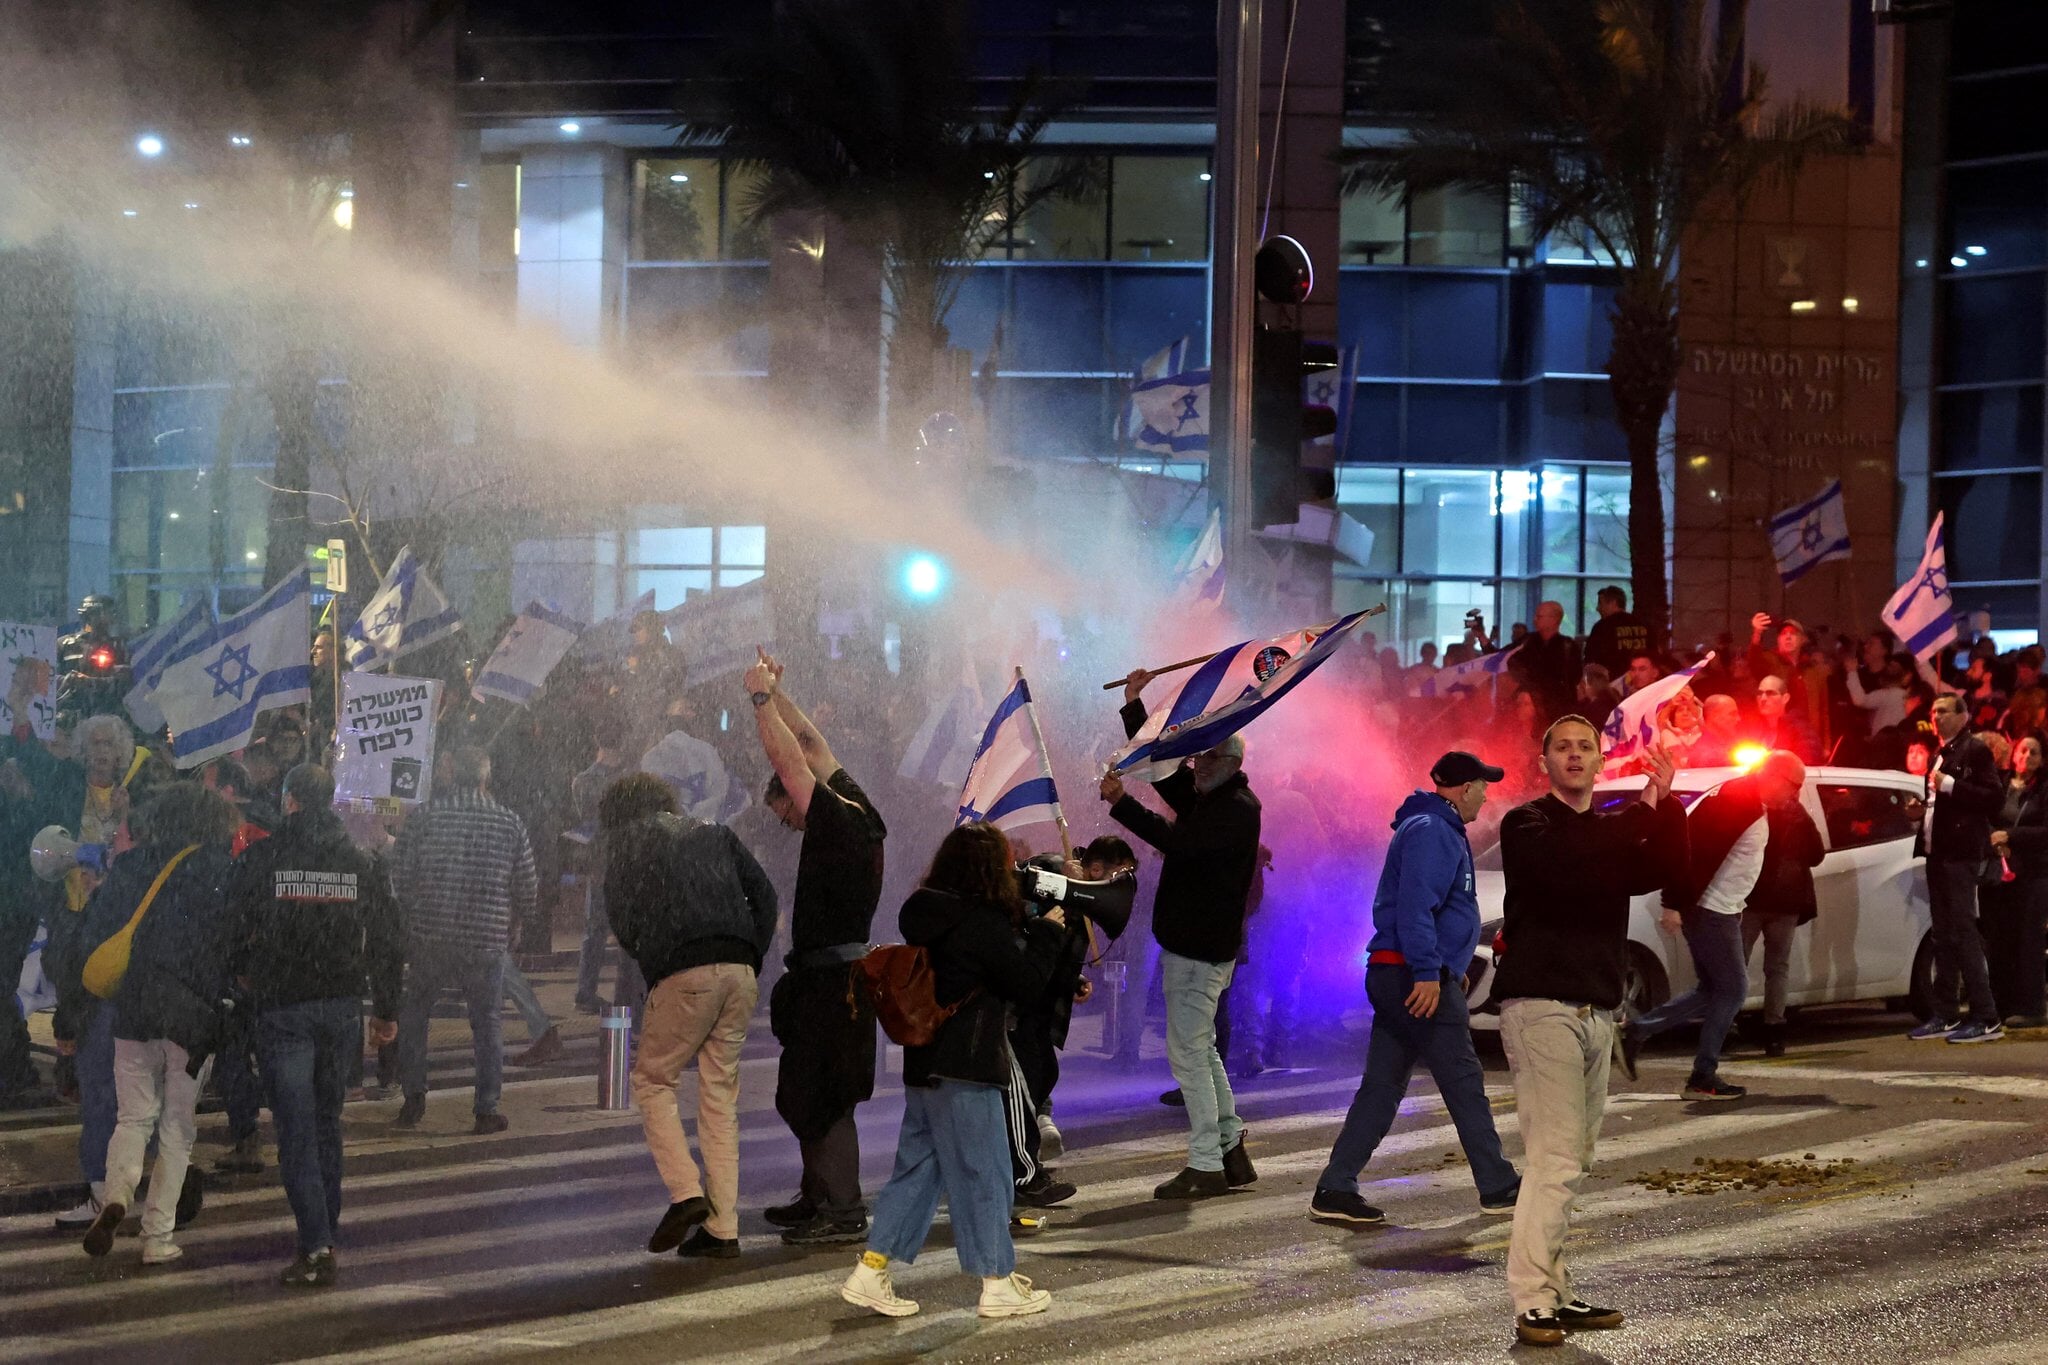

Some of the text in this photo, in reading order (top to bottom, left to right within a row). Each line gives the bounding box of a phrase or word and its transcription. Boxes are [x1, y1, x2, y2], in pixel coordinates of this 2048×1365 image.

[1693, 347, 1882, 381] קריית הממשלה
[1743, 383, 1834, 413] תל איב
[347, 684, 428, 714] ממשלה
[358, 727, 414, 755] לפח
[276, 883, 358, 900] החטופים והנעדרים
